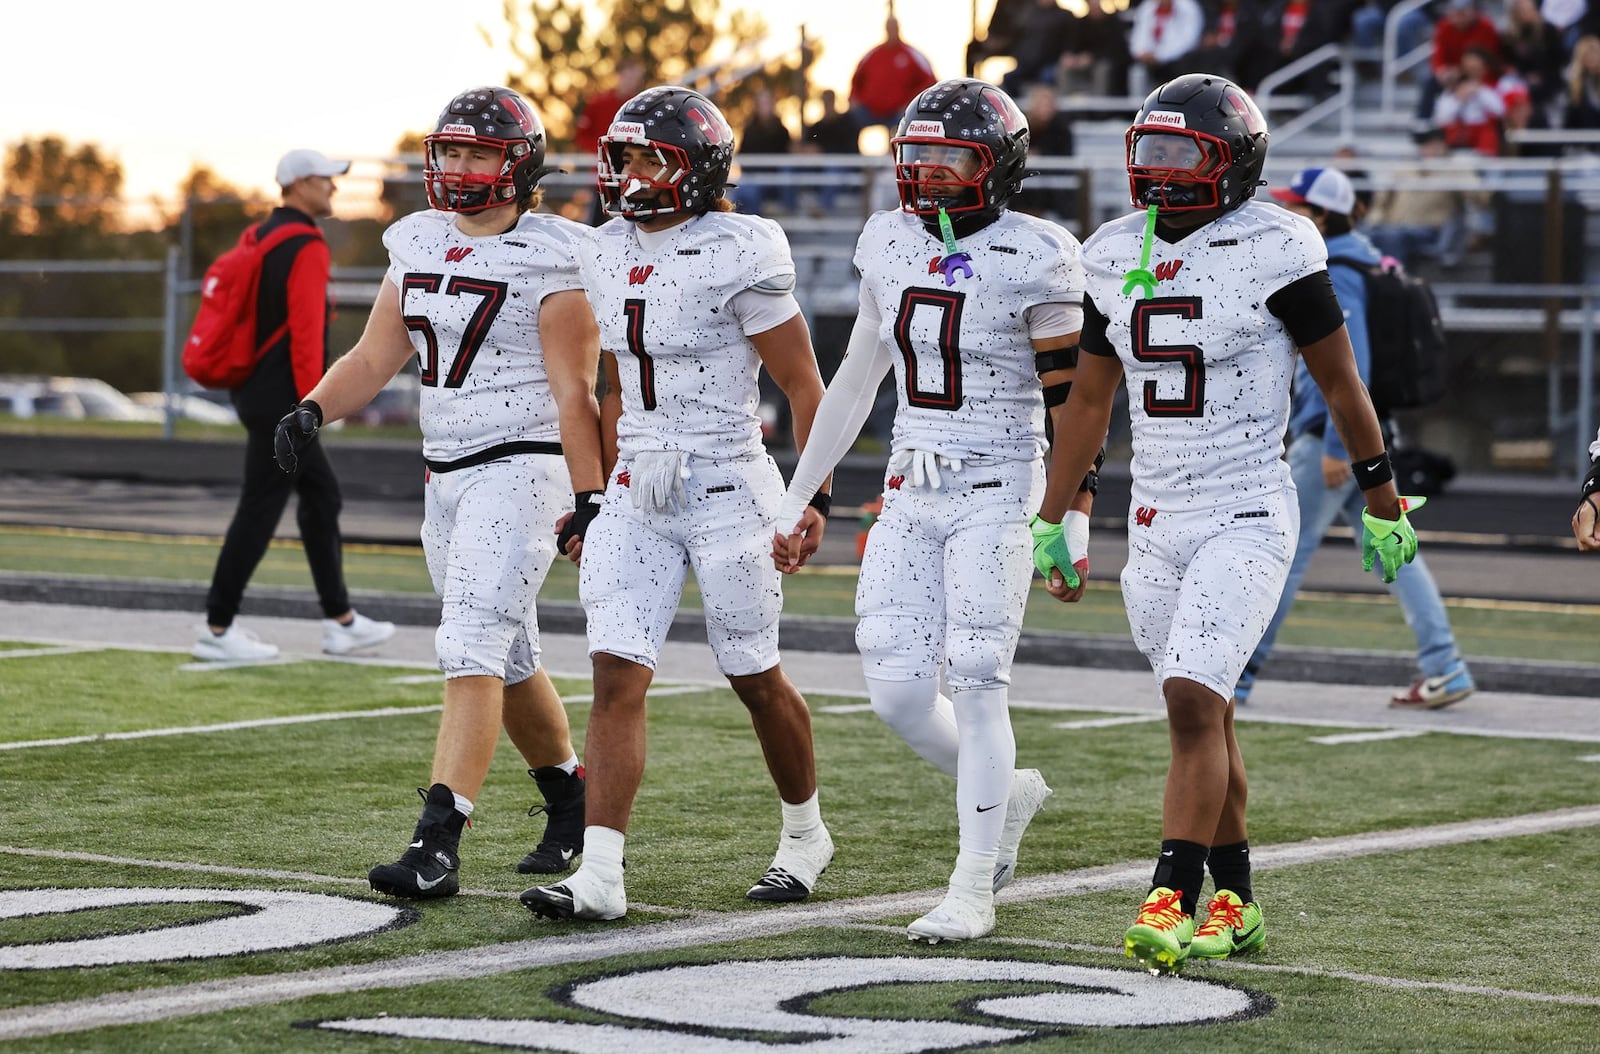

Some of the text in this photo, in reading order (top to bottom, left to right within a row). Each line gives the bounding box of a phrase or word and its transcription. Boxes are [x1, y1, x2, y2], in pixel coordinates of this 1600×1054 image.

[910, 124, 940, 133] Riddell
[1148, 113, 1182, 124] Riddell
[445, 125, 471, 133] Riddell
[614, 124, 641, 134] Riddell
[445, 247, 474, 263] W
[629, 265, 654, 285] W
[1155, 259, 1184, 281] W
[402, 272, 508, 388] 57
[624, 299, 656, 410] 1
[894, 286, 966, 411] 0
[1131, 296, 1205, 417] 5
[1136, 506, 1157, 527] W
